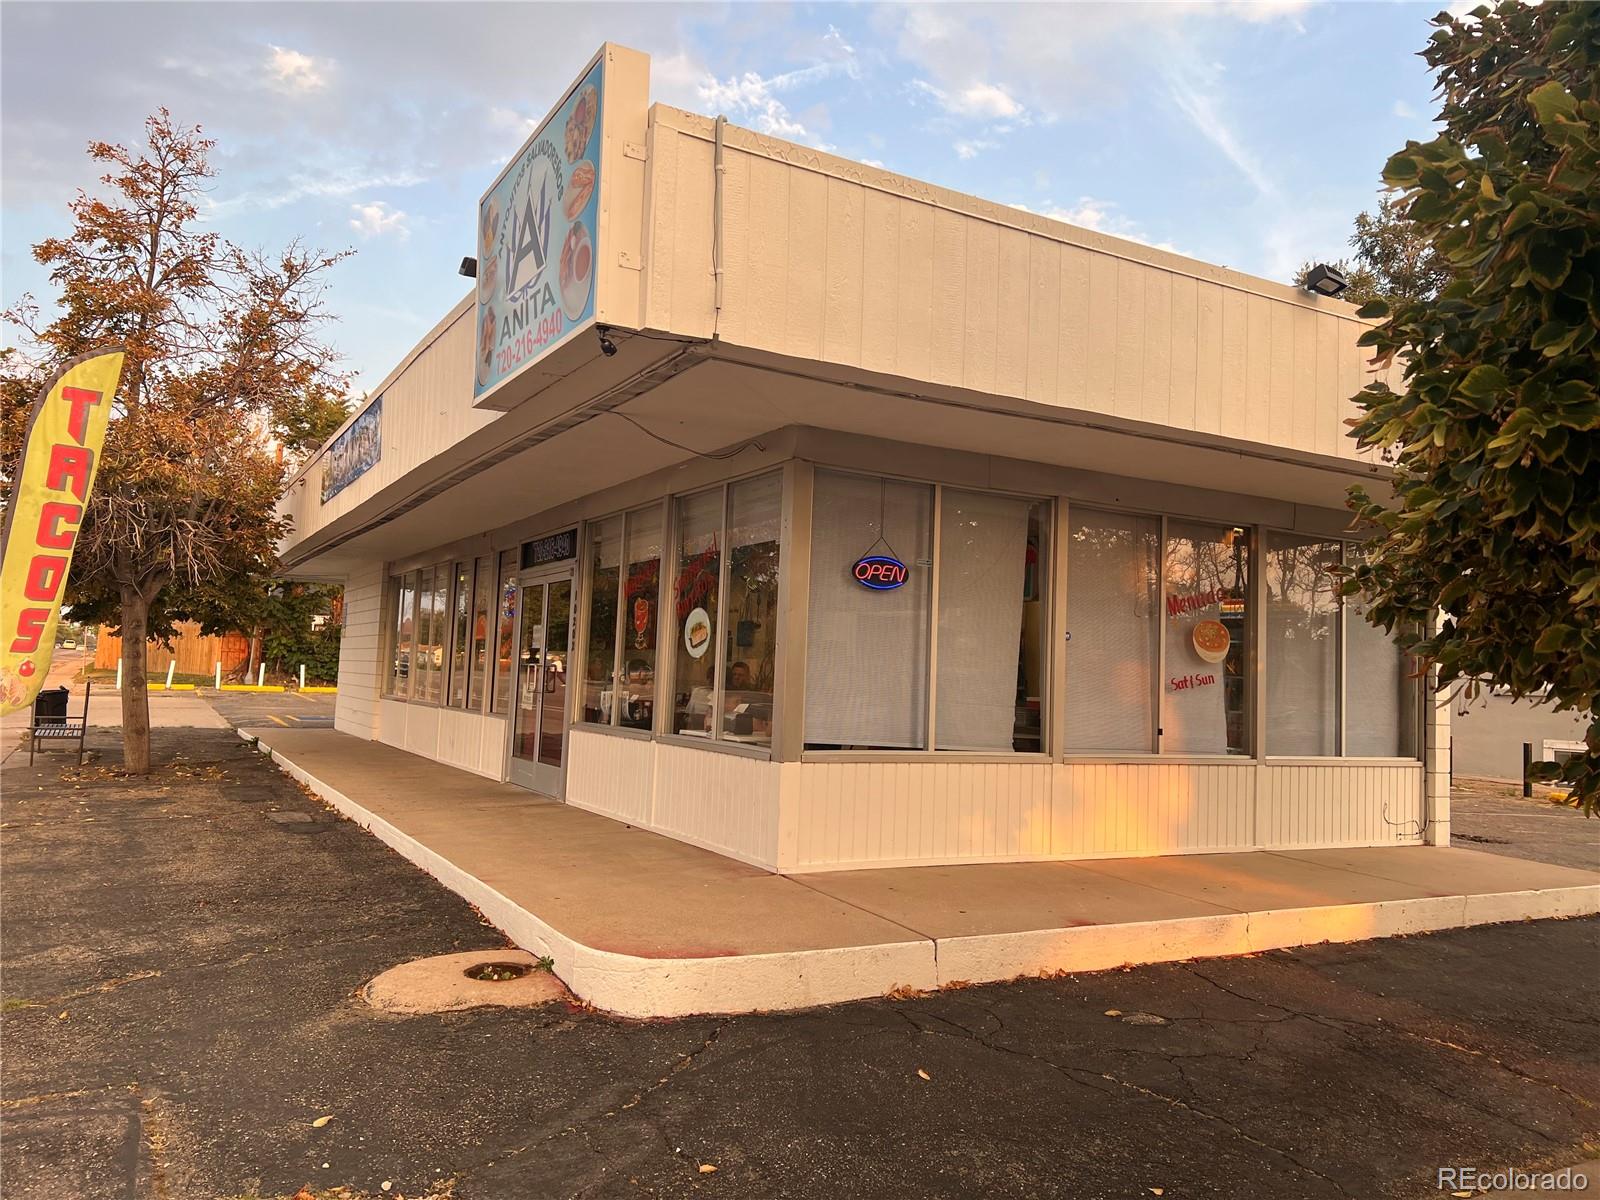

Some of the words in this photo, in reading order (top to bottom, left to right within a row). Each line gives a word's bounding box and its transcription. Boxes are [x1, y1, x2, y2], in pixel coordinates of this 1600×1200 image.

[495, 307, 563, 376] 720-216-4940
[499, 281, 556, 346] ANITA
[9, 386, 104, 654] TACOS
[855, 562, 906, 582] OPEN
[1170, 675, 1188, 691] Sat
[1195, 673, 1215, 687] Sun
